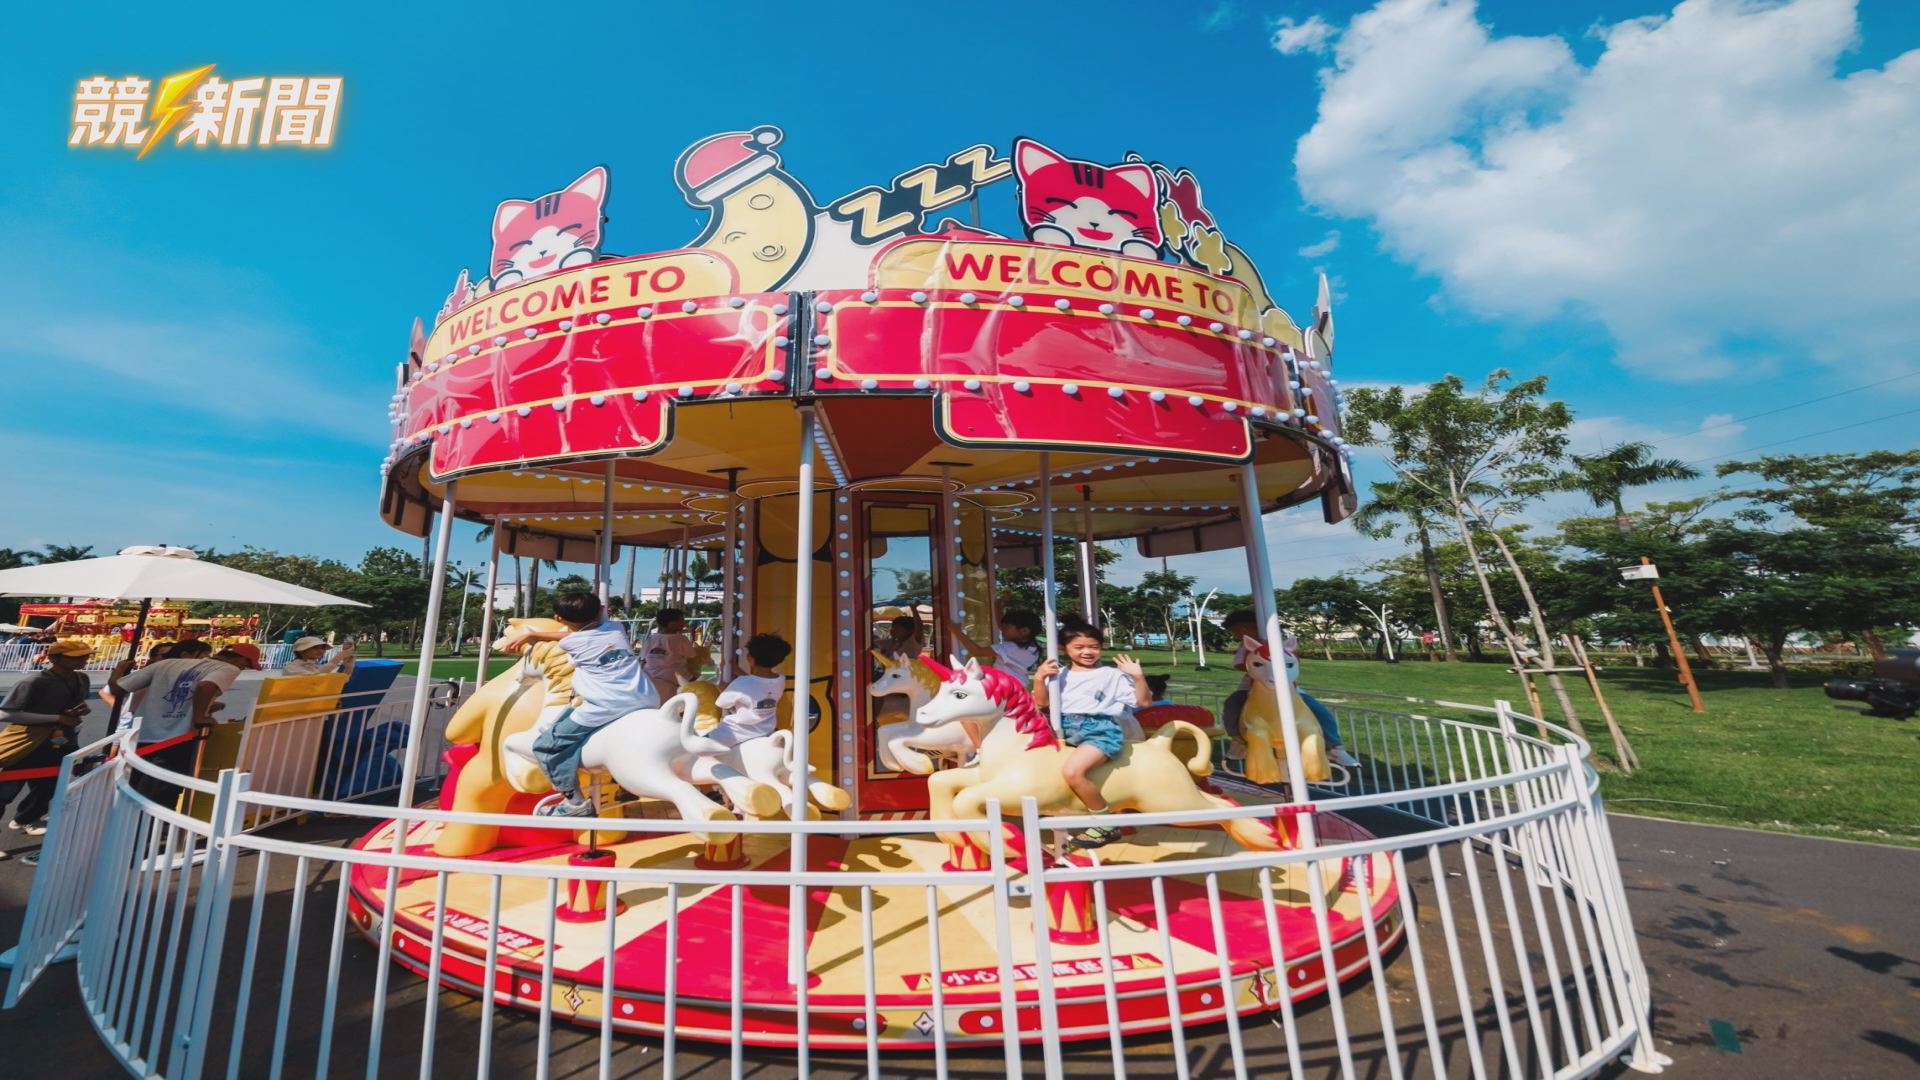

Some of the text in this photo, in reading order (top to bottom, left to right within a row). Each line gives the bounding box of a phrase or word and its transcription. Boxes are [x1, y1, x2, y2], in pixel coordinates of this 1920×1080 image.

[450, 266, 685, 345] WELCOME TO
[945, 253, 1234, 316] WELCOME TO
